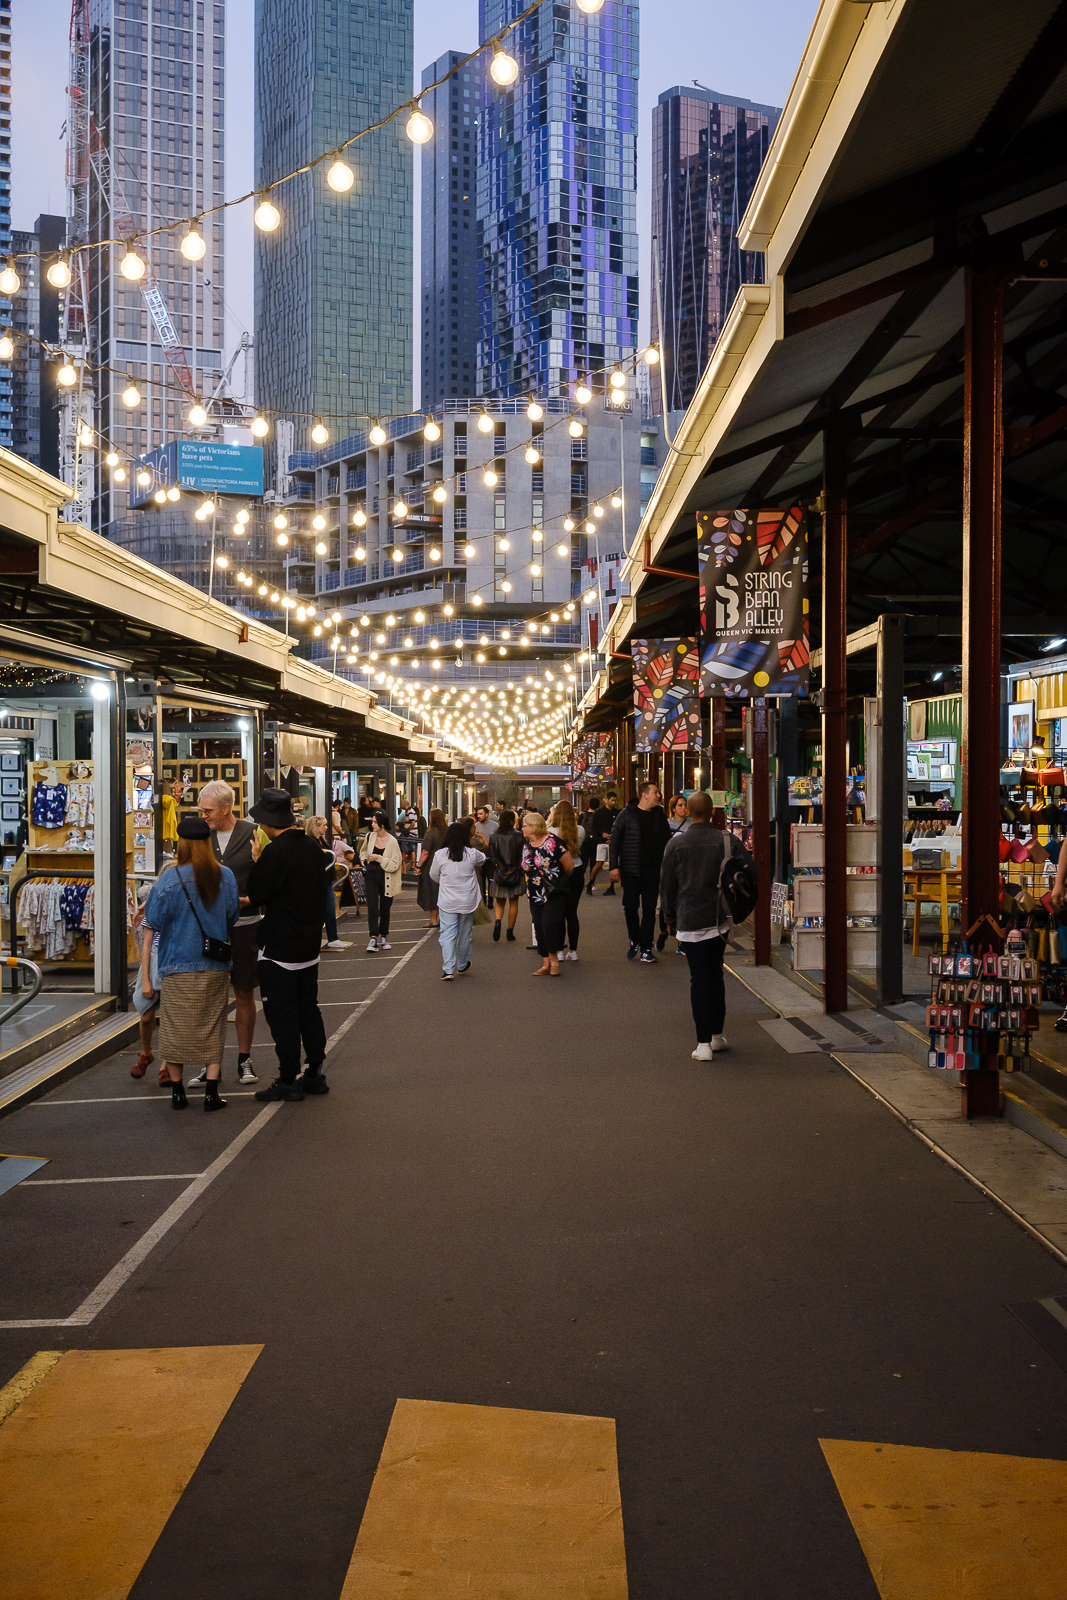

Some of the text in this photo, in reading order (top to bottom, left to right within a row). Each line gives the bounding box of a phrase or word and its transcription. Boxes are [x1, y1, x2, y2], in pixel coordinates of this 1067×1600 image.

[207, 446, 241, 456] Victorians
[181, 452, 198, 461] have
[181, 476, 196, 486] LIV
[744, 571, 792, 590] STRING
[745, 590, 780, 609] BEAN
[745, 608, 784, 627] ALLEY
[715, 629, 740, 637] QUEEN
[754, 627, 784, 635] MARKET
